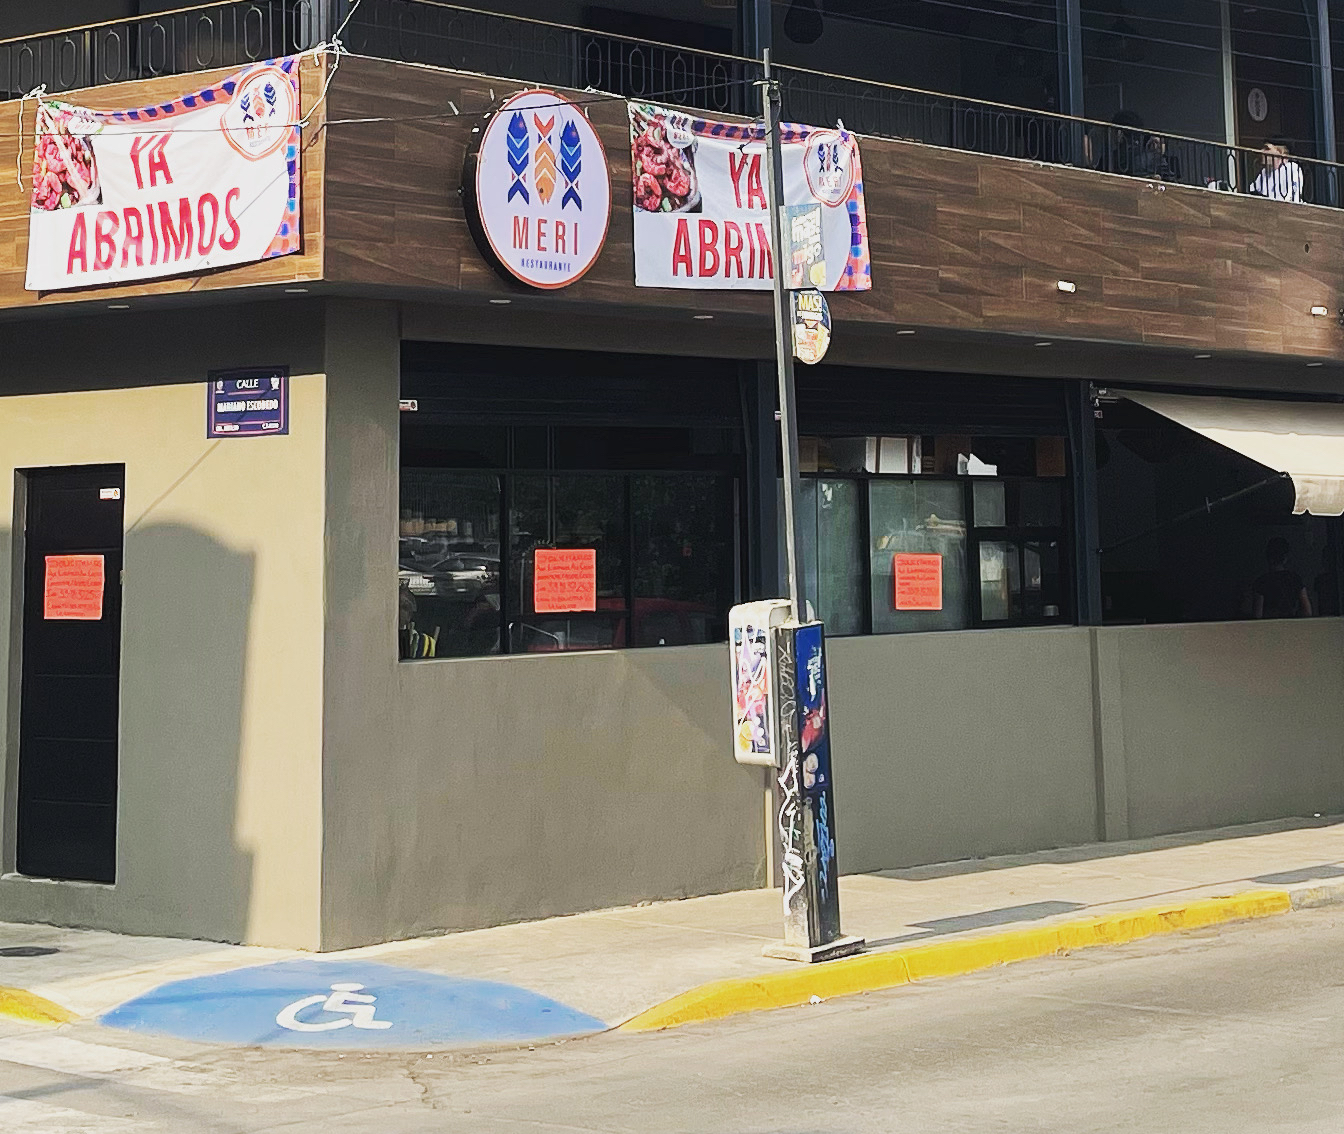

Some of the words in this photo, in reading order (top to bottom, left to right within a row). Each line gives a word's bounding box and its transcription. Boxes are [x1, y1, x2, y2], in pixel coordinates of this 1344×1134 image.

[129, 129, 174, 189] YA
[728, 152, 768, 210] YA
[67, 187, 241, 275] ABRIMOS
[512, 215, 578, 256] MERI
[521, 258, 571, 273] RESTAURANTE
[236, 378, 259, 389] CALLE
